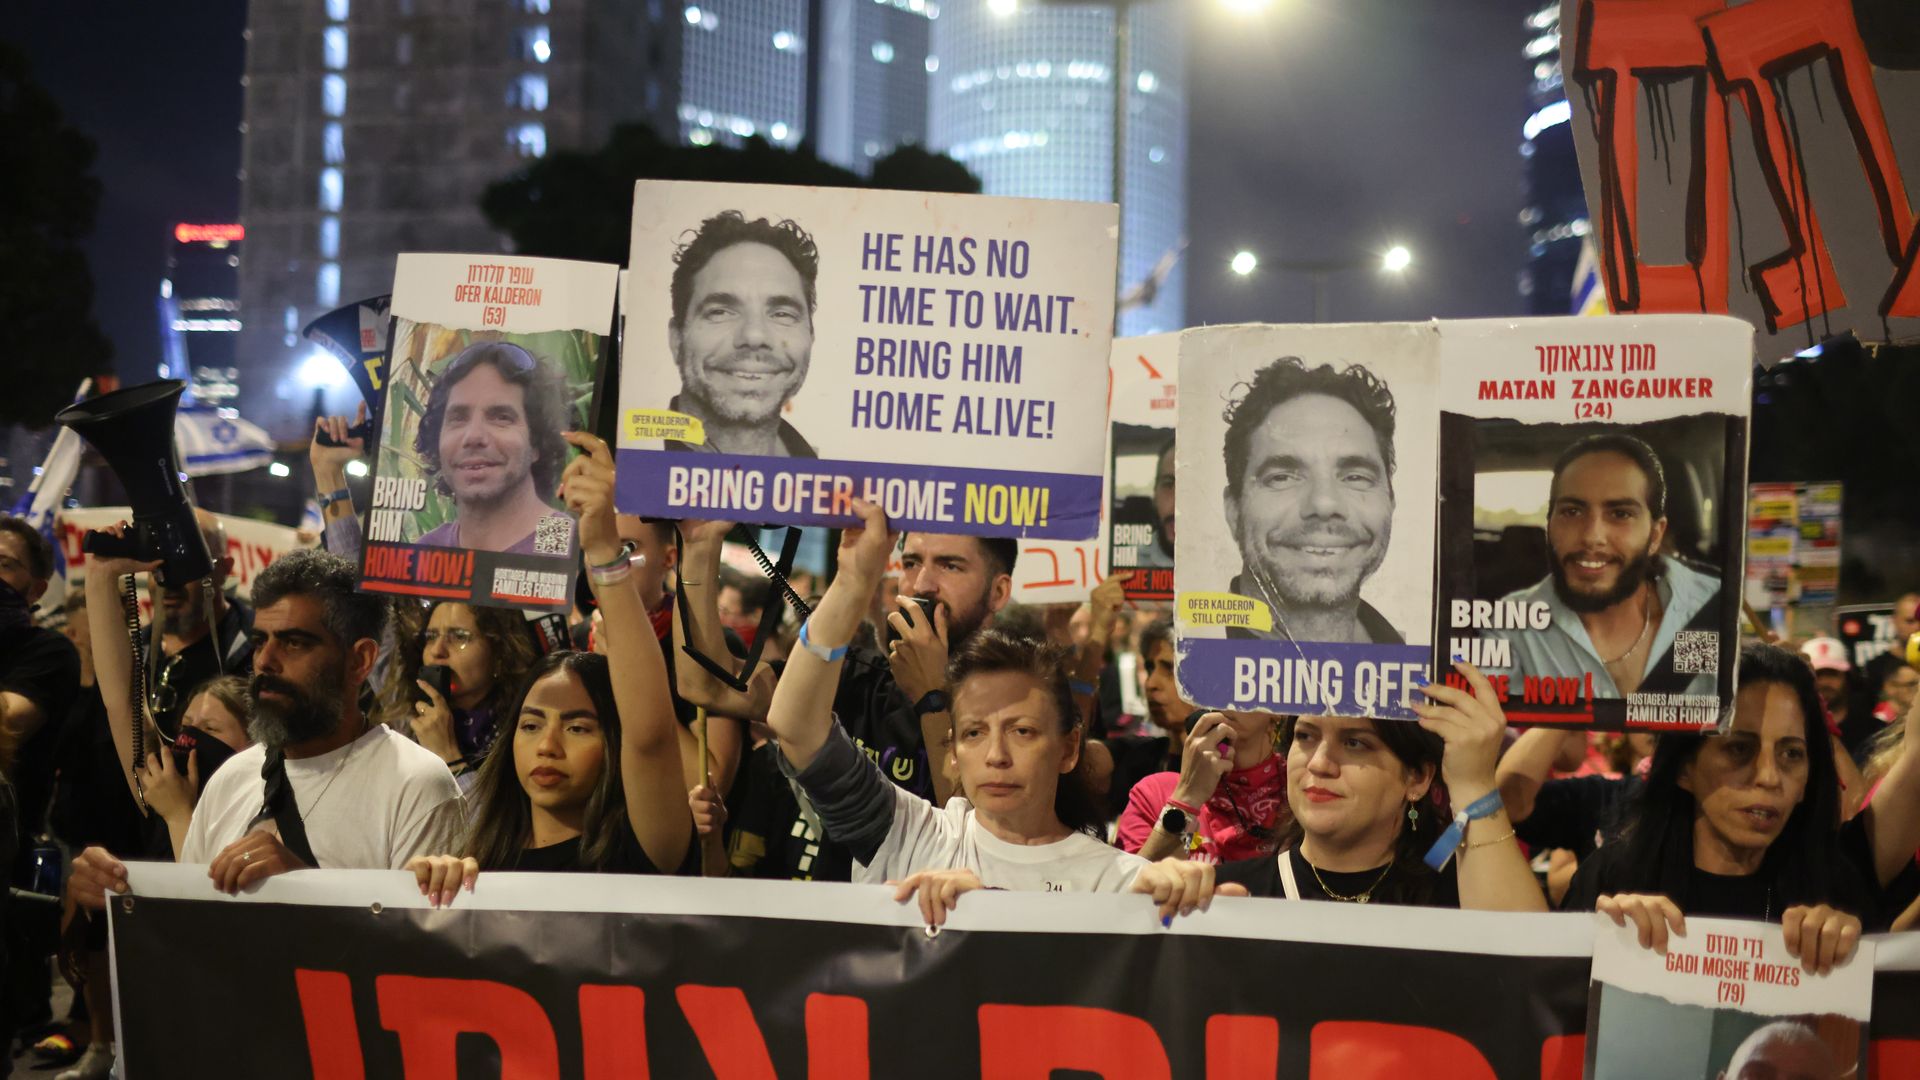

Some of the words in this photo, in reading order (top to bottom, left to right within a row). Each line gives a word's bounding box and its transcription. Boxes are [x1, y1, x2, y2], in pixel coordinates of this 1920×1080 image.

[862, 232, 904, 272] HE
[913, 235, 977, 276] HAS
[986, 239, 1030, 279] NO
[468, 264, 505, 285] קלדרון
[508, 266, 534, 285] עופר
[455, 284, 481, 303] OFER
[483, 286, 542, 306] KALDERON
[482, 306, 506, 327] (53)
[859, 284, 936, 326] TIME
[945, 289, 984, 329] TO
[994, 292, 1079, 335] WAIT.
[855, 337, 952, 380] BRING
[961, 343, 1023, 384] HIM
[1535, 344, 1614, 375] צנגאוקר
[1621, 344, 1656, 374] מתן
[1478, 380, 1556, 400] MATAN
[1571, 378, 1713, 400] ZANGAUKER
[632, 414, 651, 425] OFER
[652, 415, 690, 426] KALDERON
[851, 389, 944, 433] HOME
[952, 395, 1055, 439] ALIVE!
[1574, 402, 1613, 420] (24)
[635, 427, 653, 437] STILL
[656, 428, 686, 439] CAPTIVE
[372, 476, 427, 511] BRING
[667, 466, 764, 513] BRING
[773, 473, 854, 516] OFER
[863, 477, 956, 521] HOME
[964, 483, 1050, 528] NOW!
[368, 509, 405, 543] HIM
[1113, 524, 1153, 546] BRING
[364, 546, 415, 580] HOME
[415, 549, 475, 587] NOW!
[1112, 546, 1137, 568] HIM
[492, 579, 534, 597] FAMILIES
[533, 582, 567, 600] FORUM
[1188, 598, 1209, 610] OFER
[1211, 599, 1255, 611] KALDERON
[1450, 600, 1551, 630] BRING
[1192, 613, 1214, 624] STILL
[1216, 614, 1250, 625] CAPTIVE
[1450, 638, 1512, 668] HIM
[1233, 657, 1344, 706] BRING
[1354, 661, 1431, 709] OFE
[1523, 672, 1593, 712] NOW!
[1626, 693, 1667, 706] HOSTAGES
[1667, 695, 1684, 707] AND
[1685, 695, 1720, 709] MISSING
[1626, 704, 1678, 723] FAMILIES
[1679, 706, 1720, 724] FORUM
[1706, 934, 1738, 956] מוזס
[1743, 938, 1764, 960] גדי
[1665, 952, 1699, 975] GADI
[1702, 956, 1749, 981] MOSHE
[1753, 963, 1801, 987] MOZES
[1717, 981, 1745, 1006] (79)
